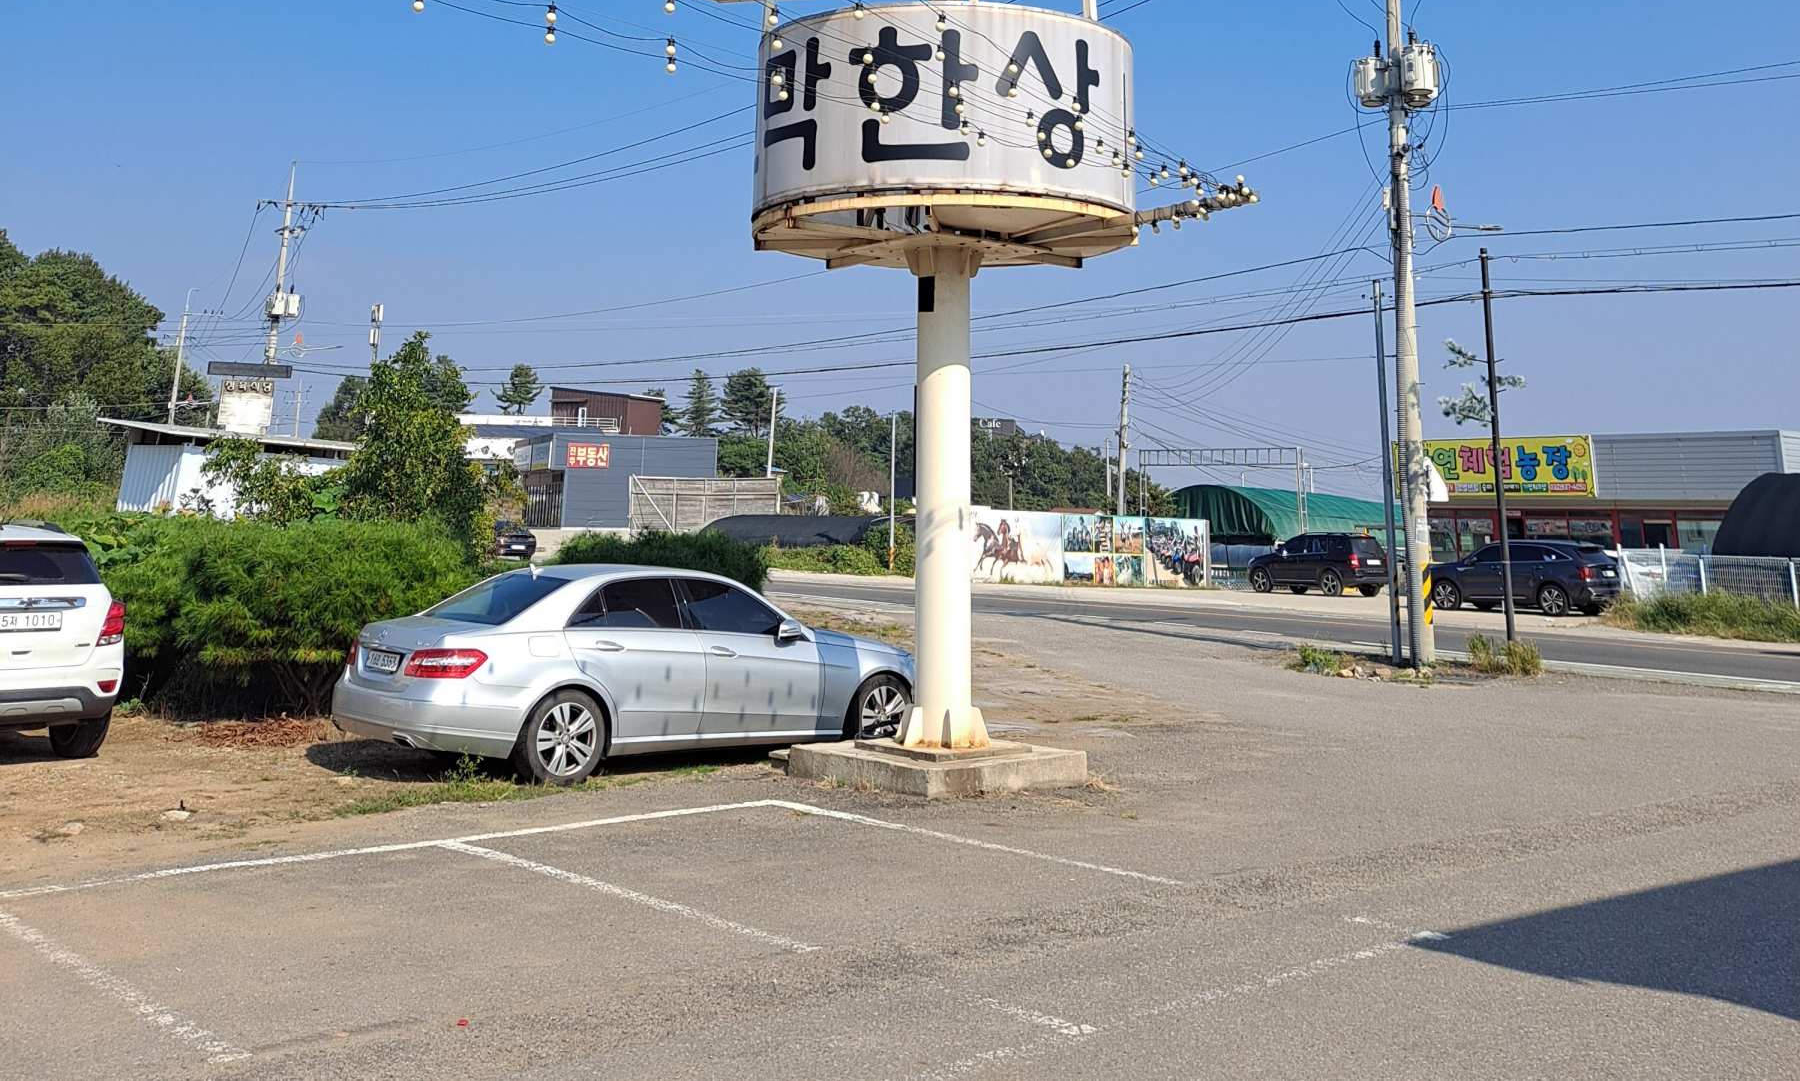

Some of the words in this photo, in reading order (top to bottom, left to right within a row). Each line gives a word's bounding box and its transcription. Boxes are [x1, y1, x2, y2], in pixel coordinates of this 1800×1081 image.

[754, 26, 1100, 170] 막한상
[577, 446, 608, 466] 부동산
[25, 614, 55, 627] 1010
